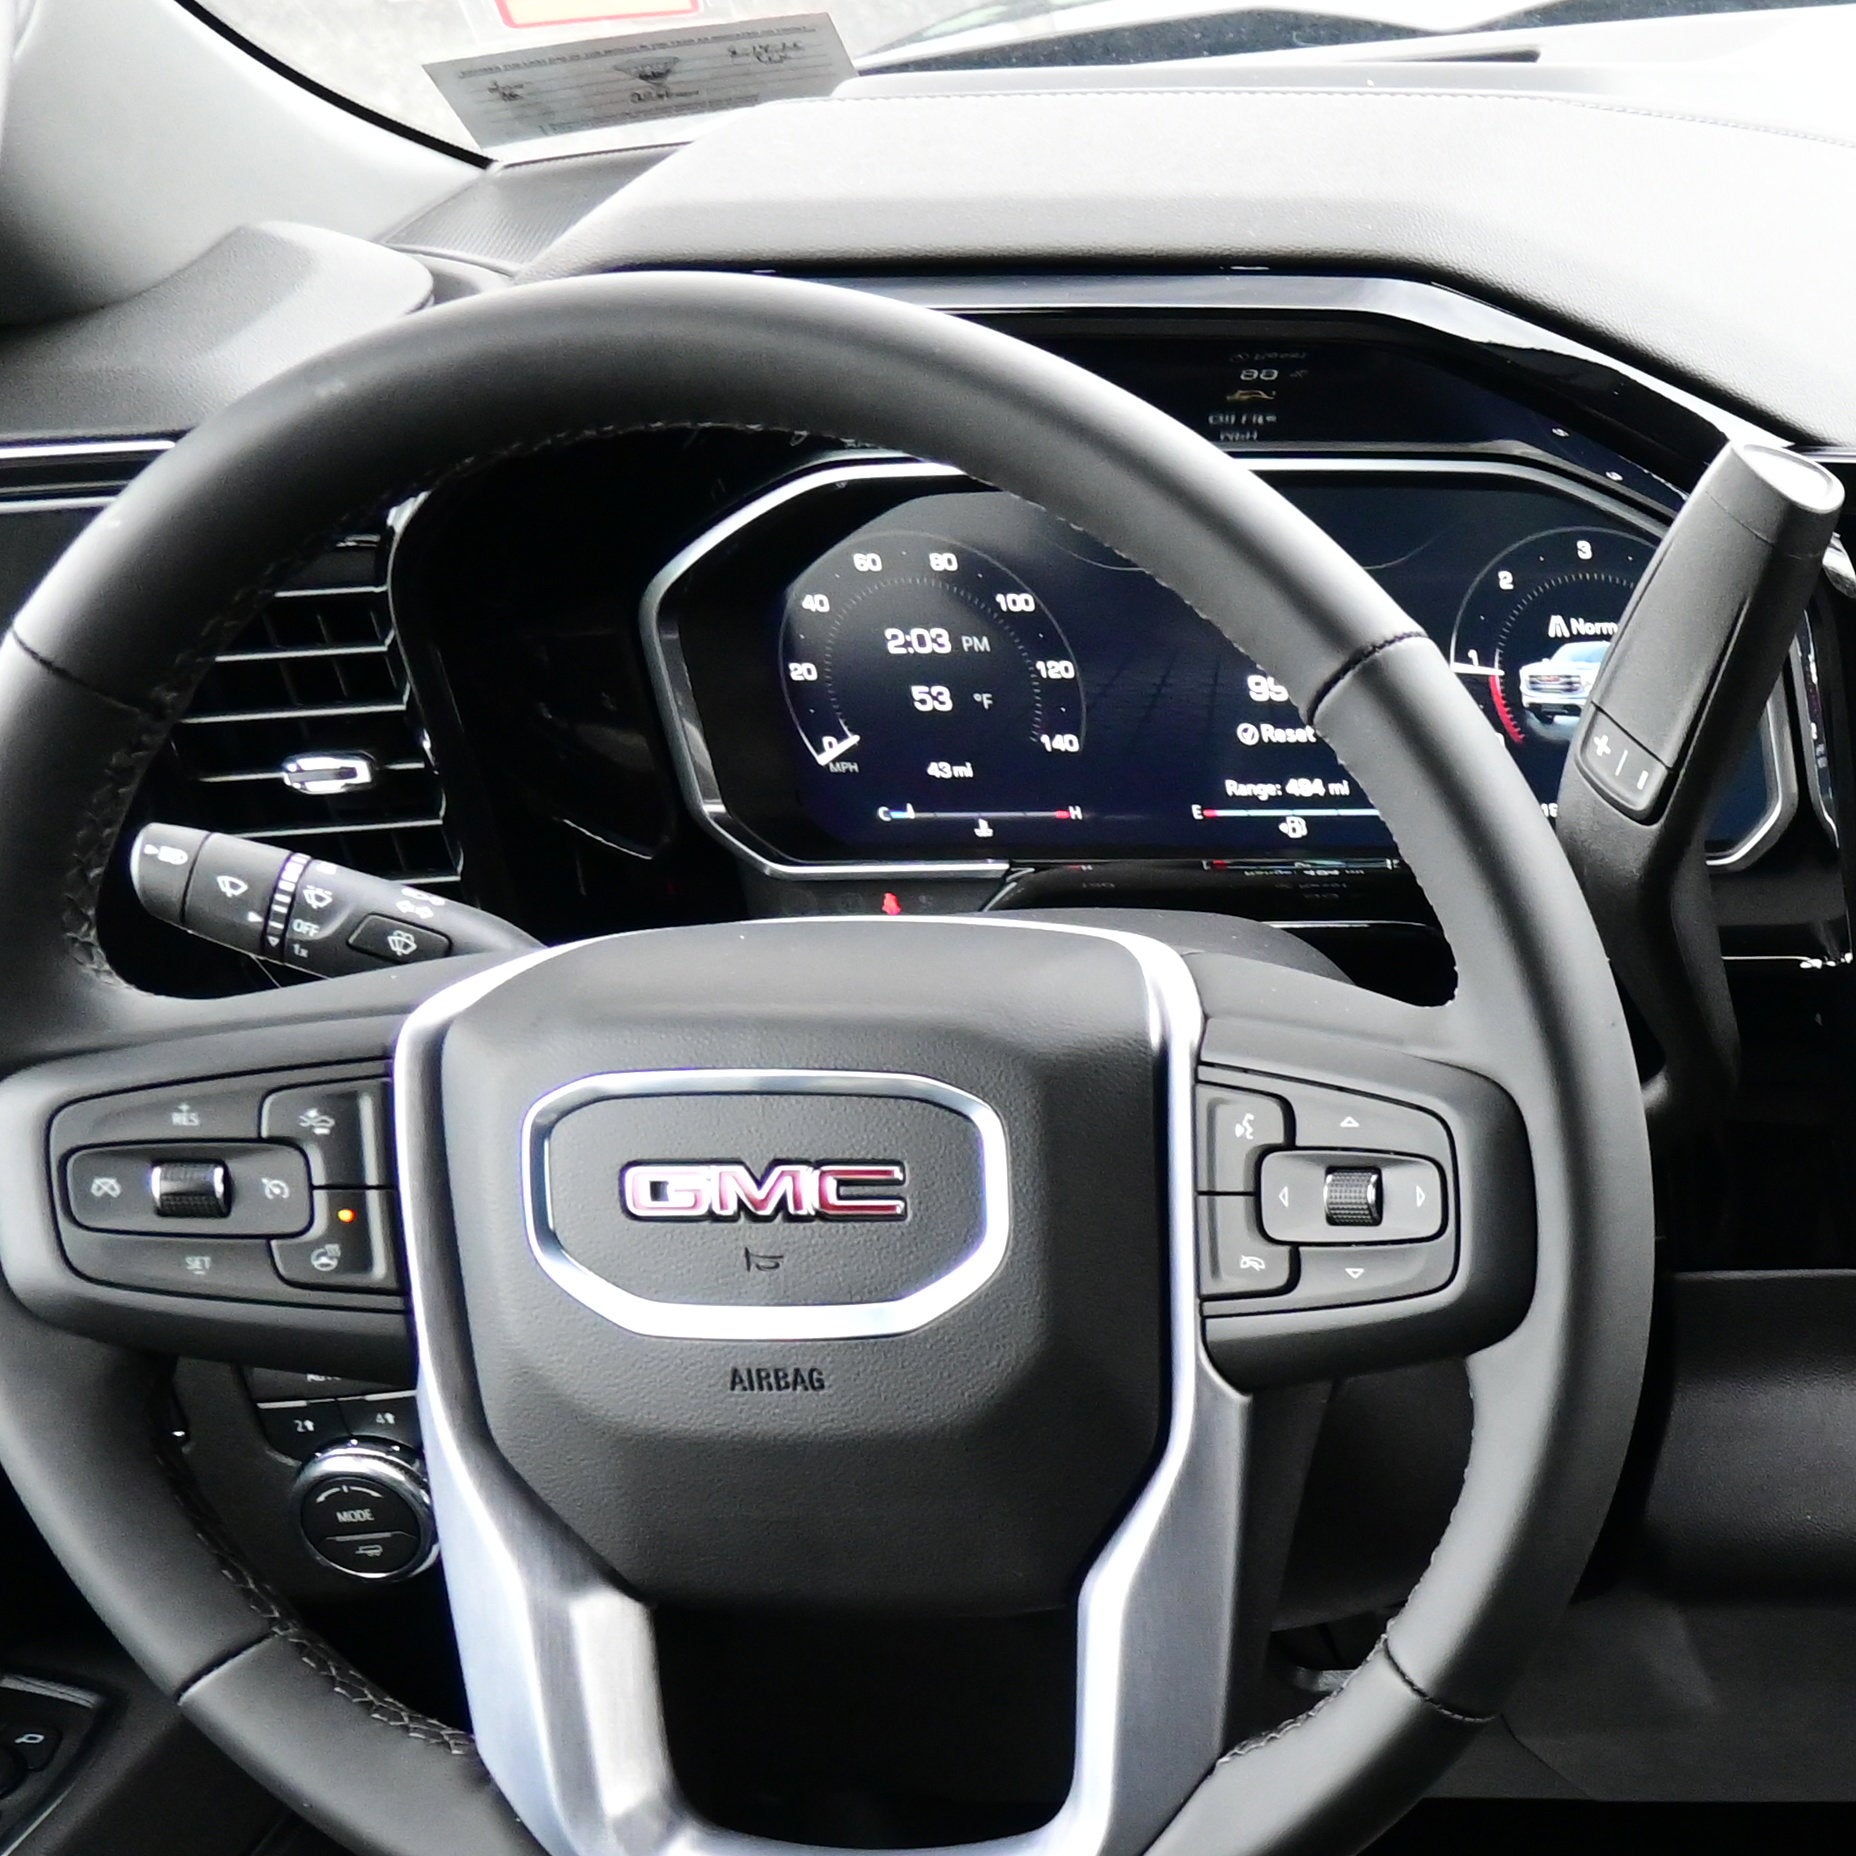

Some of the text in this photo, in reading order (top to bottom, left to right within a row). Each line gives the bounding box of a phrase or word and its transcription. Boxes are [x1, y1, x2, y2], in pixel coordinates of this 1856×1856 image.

[1577, 540, 1592, 561] 3
[854, 553, 882, 572] 60
[929, 553, 959, 572] 80
[1498, 570, 1513, 591] 2
[801, 594, 830, 613] 40
[996, 594, 1035, 612] 100
[1570, 617, 1618, 636] Norm
[884, 628, 991, 655] 2:03 PM
[789, 662, 818, 681] 20
[1036, 660, 1075, 680] 120
[910, 685, 953, 713] 53
[1040, 733, 1080, 753] 140
[1261, 724, 1316, 744] Reset
[829, 760, 860, 775] MPH
[1225, 778, 1283, 799] Range:
[1329, 780, 1350, 796] mi
[1069, 806, 1082, 819] H
[1192, 805, 1203, 819] E
[293, 919, 320, 938] OFF
[622, 1160, 906, 1221] GMC
[186, 1255, 211, 1271] SET
[729, 1367, 826, 1392] AIRBAG
[336, 1509, 375, 1522] MODE
